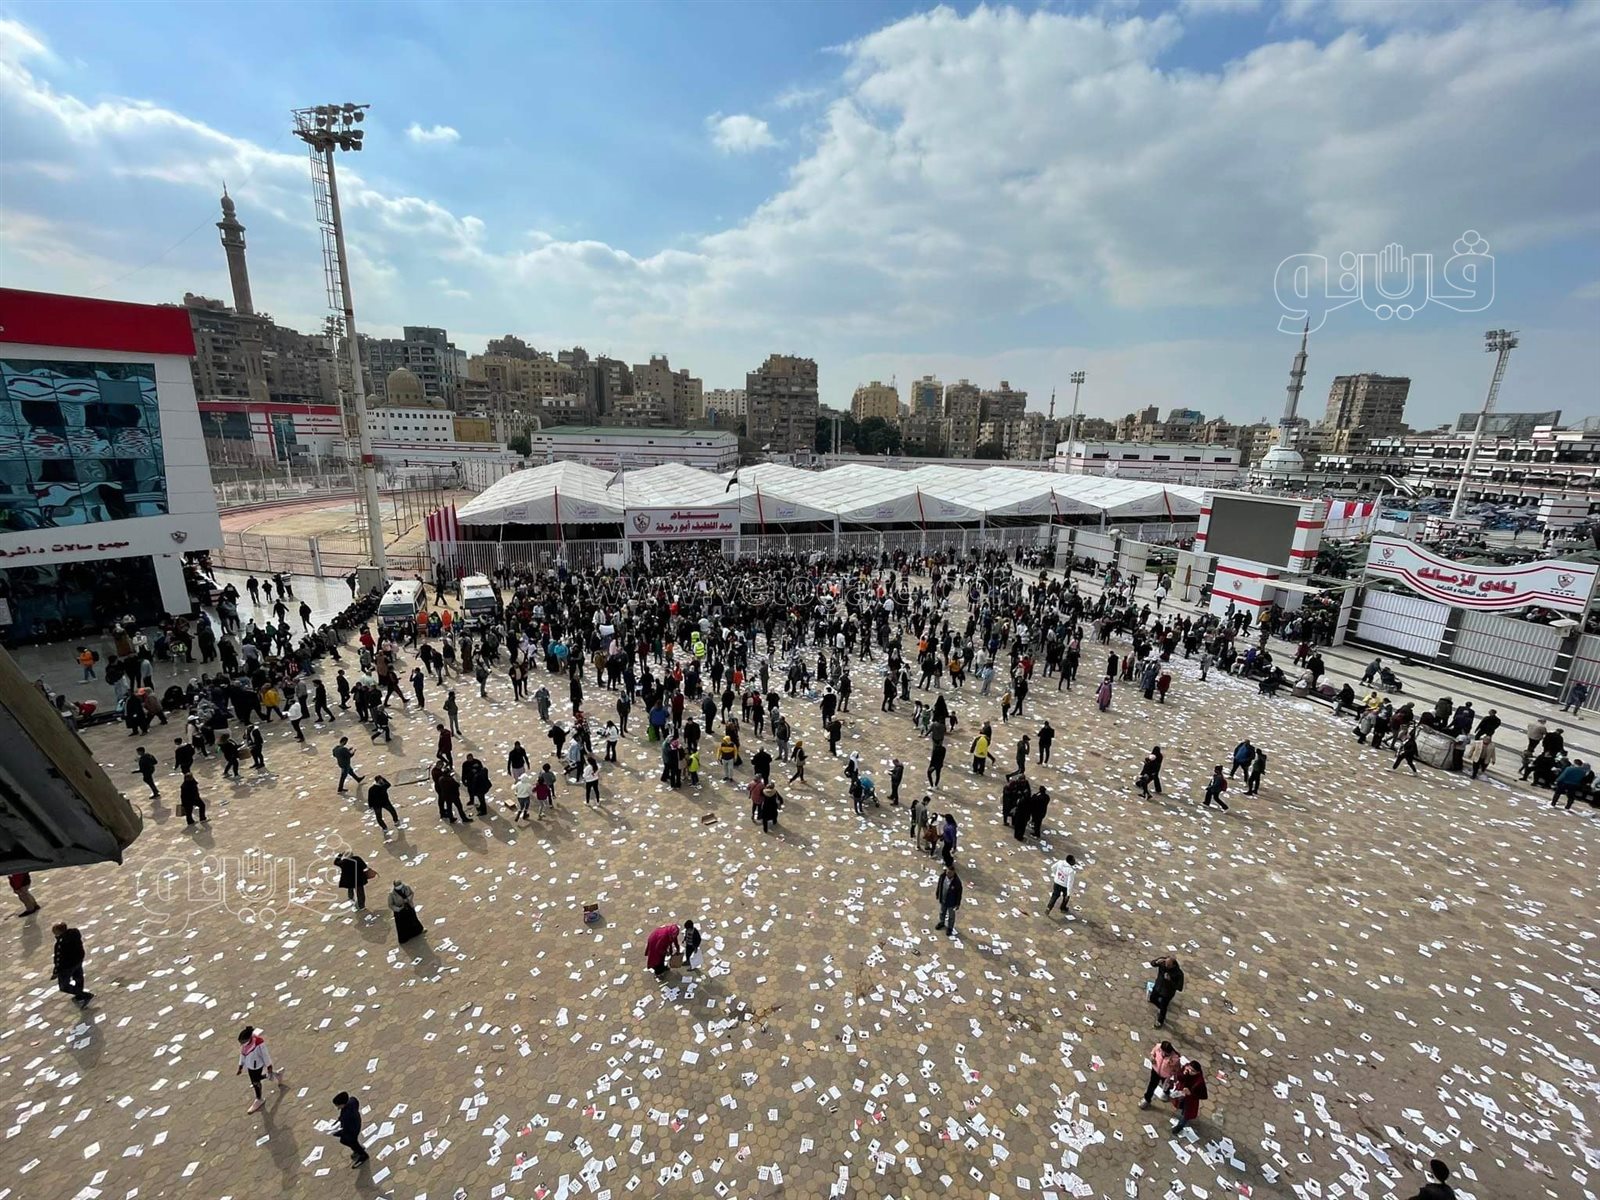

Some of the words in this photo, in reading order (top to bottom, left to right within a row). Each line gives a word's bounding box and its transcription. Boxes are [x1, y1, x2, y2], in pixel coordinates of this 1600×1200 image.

[670, 511, 719, 520] ستاد
[692, 521, 718, 532] اللطيف
[51, 543, 93, 553] صالات
[97, 541, 130, 551] مجمع
[1416, 566, 1477, 587] الزمالك
